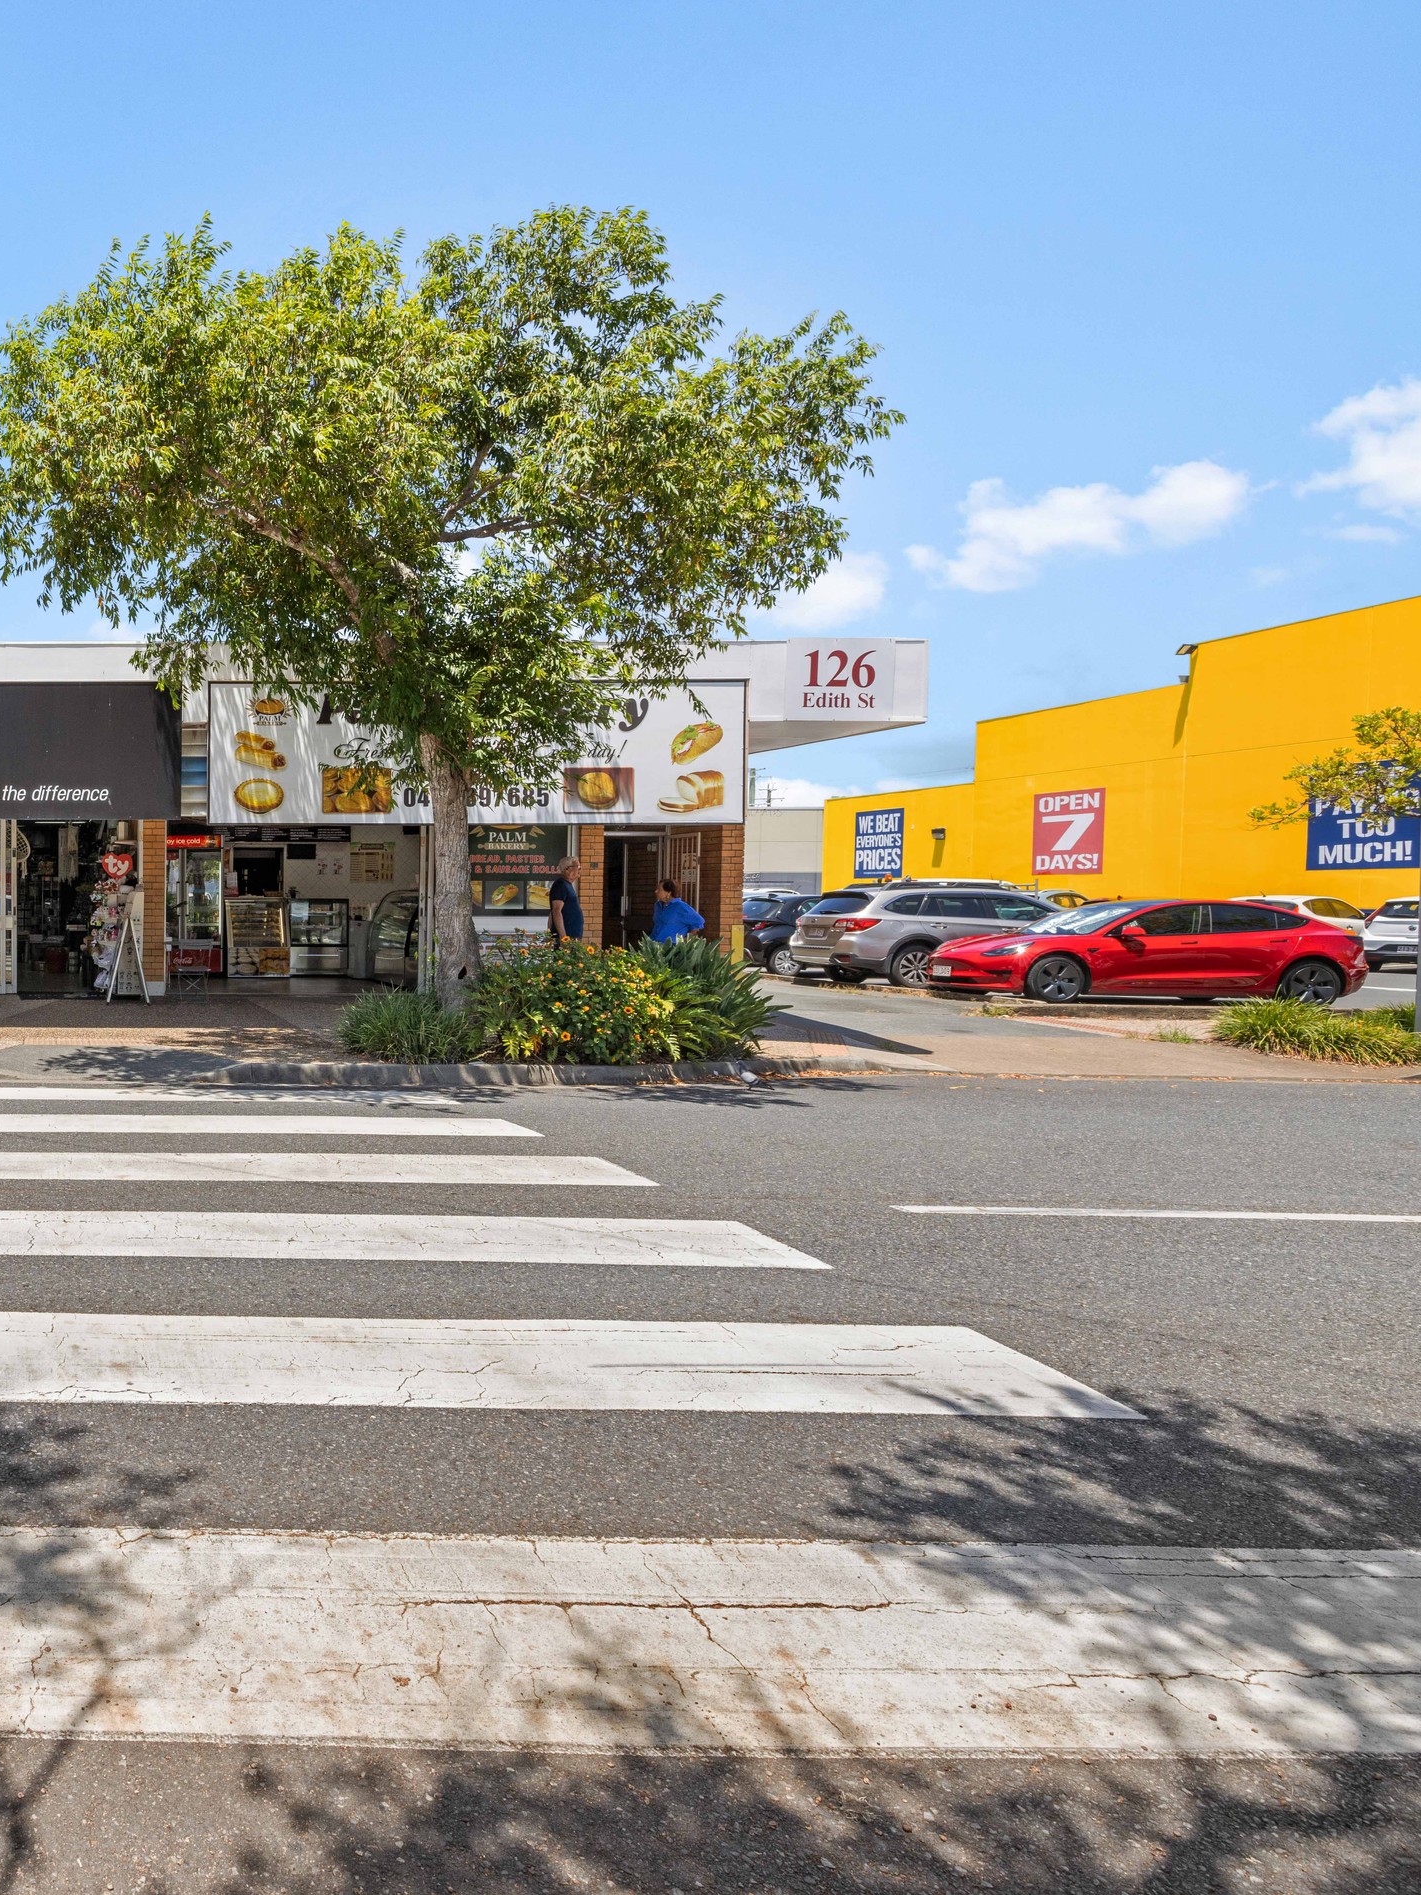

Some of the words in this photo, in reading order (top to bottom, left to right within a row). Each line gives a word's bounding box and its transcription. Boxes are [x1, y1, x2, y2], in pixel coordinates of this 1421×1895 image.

[803, 649, 877, 688] 126
[802, 692, 851, 708] Edith
[858, 692, 876, 708] St
[2, 785, 27, 801] the
[31, 785, 109, 801] difference
[1038, 792, 1101, 813] OPEN
[858, 815, 874, 834] WE
[875, 813, 901, 834] BEAT
[1041, 813, 1095, 851] 7
[1336, 816, 1396, 839] TOO
[488, 831, 527, 842] PALM
[856, 833, 902, 849] EVERYONE'S
[505, 854, 546, 863] PASTIES
[855, 848, 901, 870] PRICES
[1035, 853, 1099, 870] DAYS!
[1318, 840, 1413, 865] MUCH!
[104, 854, 130, 876] ty
[474, 865, 483, 874] &
[485, 865, 531, 874] SAUSAGE
